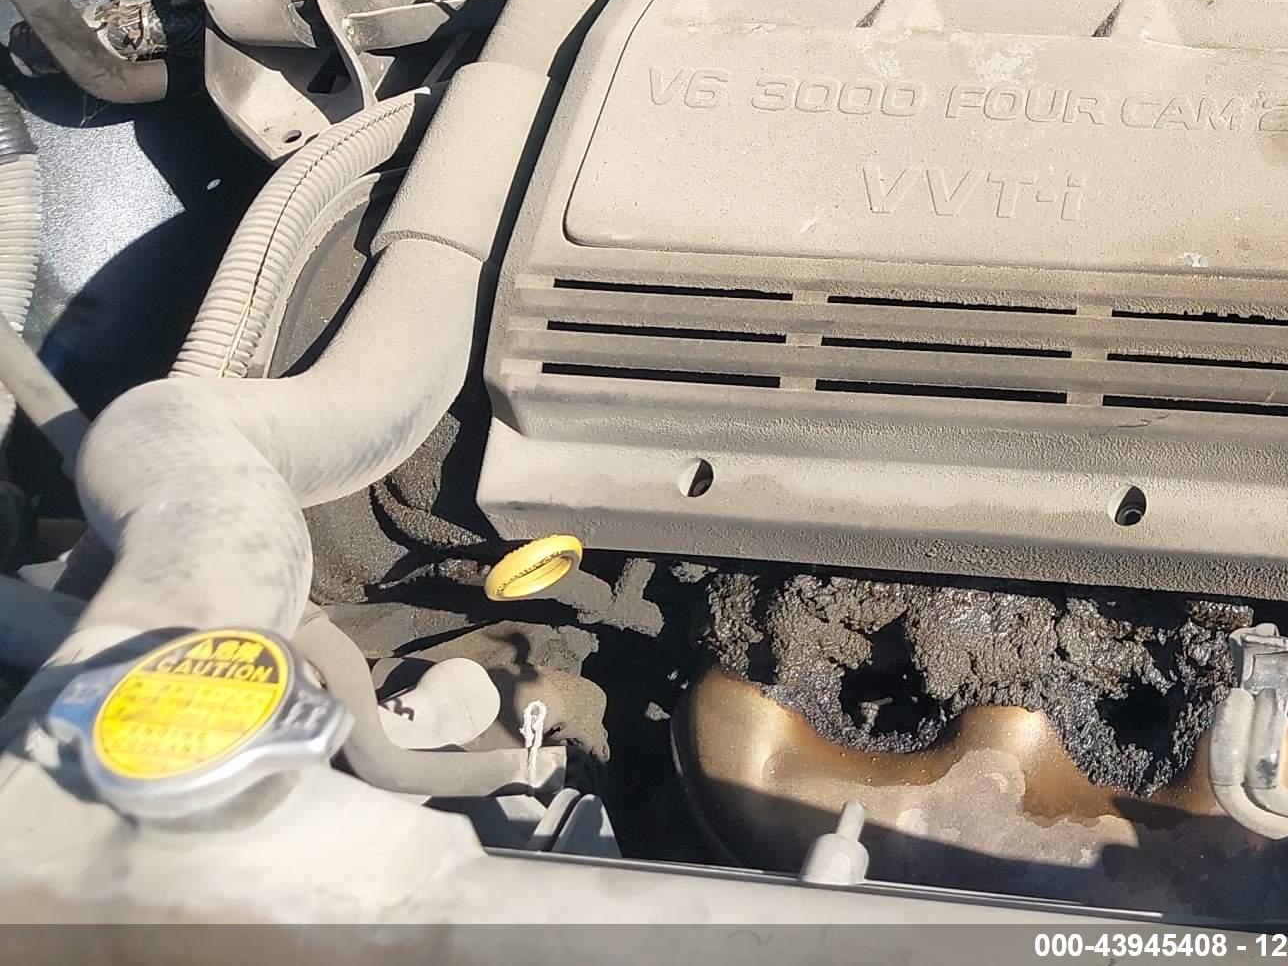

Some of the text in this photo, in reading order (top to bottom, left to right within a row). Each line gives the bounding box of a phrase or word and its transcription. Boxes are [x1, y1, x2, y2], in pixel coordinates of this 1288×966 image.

[648, 68, 731, 109] V6
[751, 75, 919, 118] 3000
[945, 84, 1106, 126] FOUR
[1120, 95, 1242, 133] CAM
[860, 164, 1087, 222] VVT-i
[156, 657, 273, 683] CAUTION
